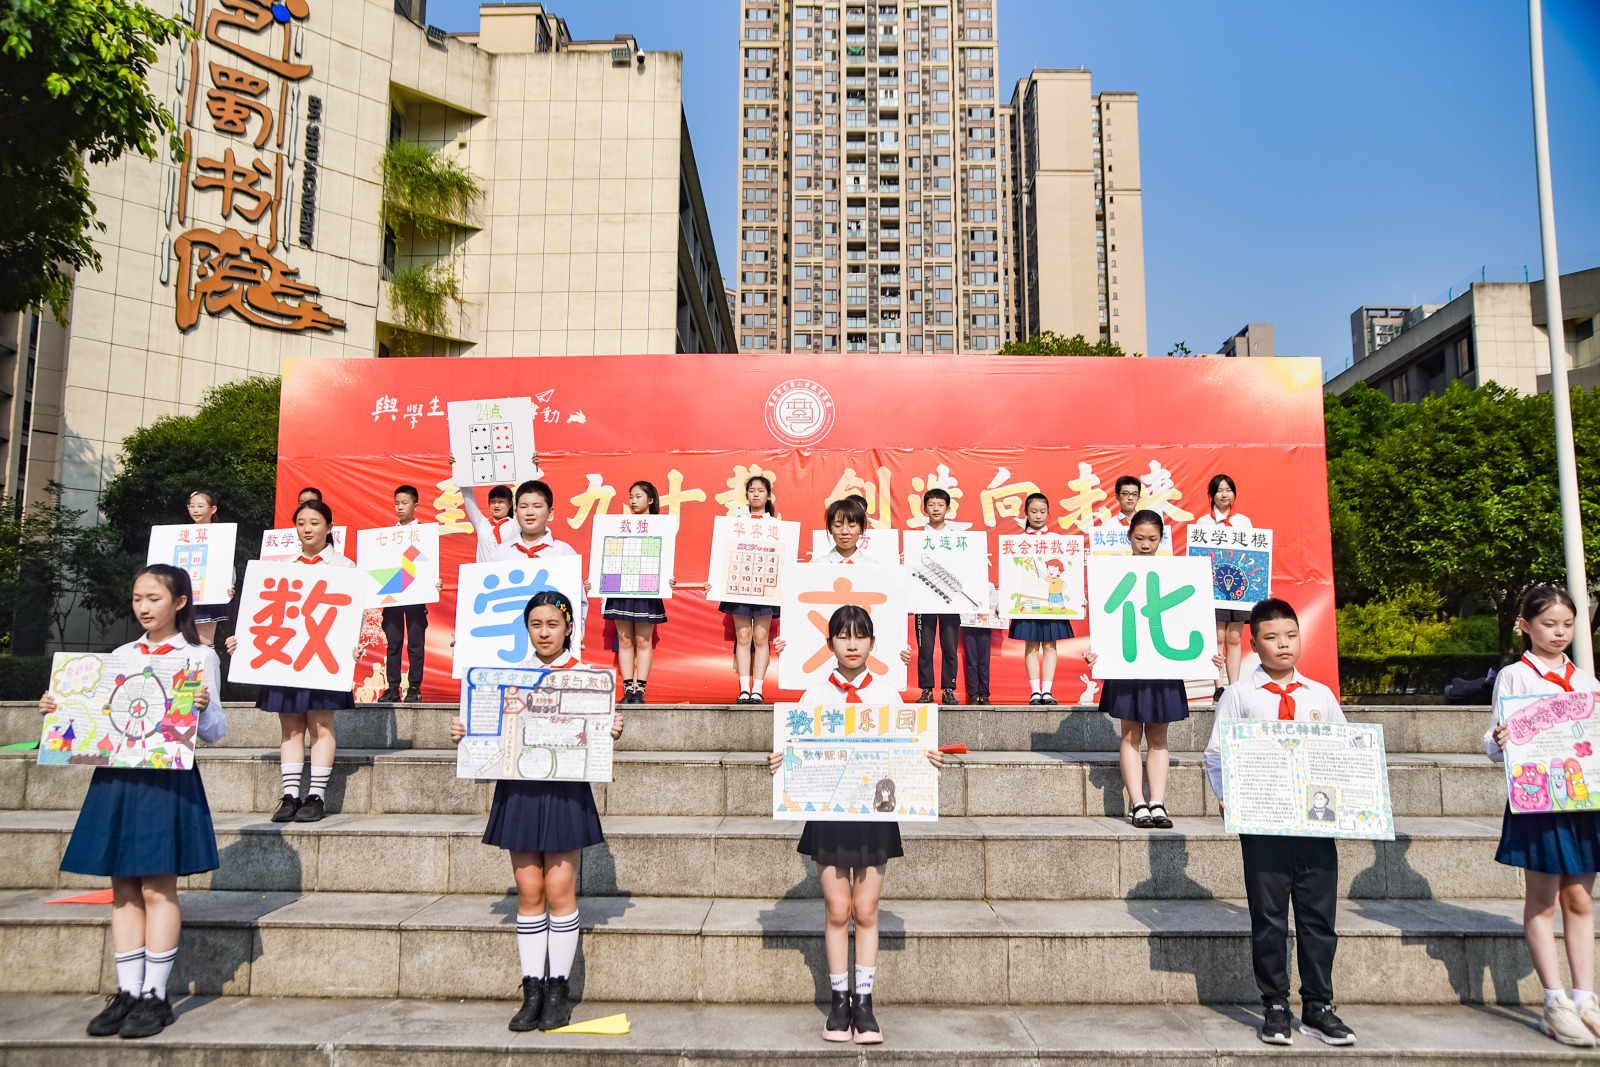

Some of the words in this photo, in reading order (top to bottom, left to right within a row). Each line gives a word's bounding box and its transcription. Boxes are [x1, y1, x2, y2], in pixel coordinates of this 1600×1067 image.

[308, 94, 321, 119] BA
[305, 123, 320, 160] SHU
[300, 161, 318, 247] ACADEMY
[477, 402, 503, 421] 24点
[177, 528, 209, 543] 速算
[620, 519, 649, 534] 数独
[733, 522, 780, 541] 华容道
[265, 530, 342, 548] 数学报
[375, 529, 421, 546] 七巧板
[858, 534, 871, 549] 方
[923, 535, 968, 551] 九连环
[1190, 528, 1268, 548] 数学建模
[1002, 540, 1080, 555] 我会讲数学
[249, 577, 352, 674] 数
[470, 569, 559, 663] 学
[1104, 571, 1204, 663] 化
[798, 577, 889, 676] 文
[476, 671, 532, 686] 数学中的
[545, 675, 610, 690] 速度与激情
[785, 708, 917, 735] 数学乐园
[1260, 722, 1333, 736] 哥德巴赫猜想
